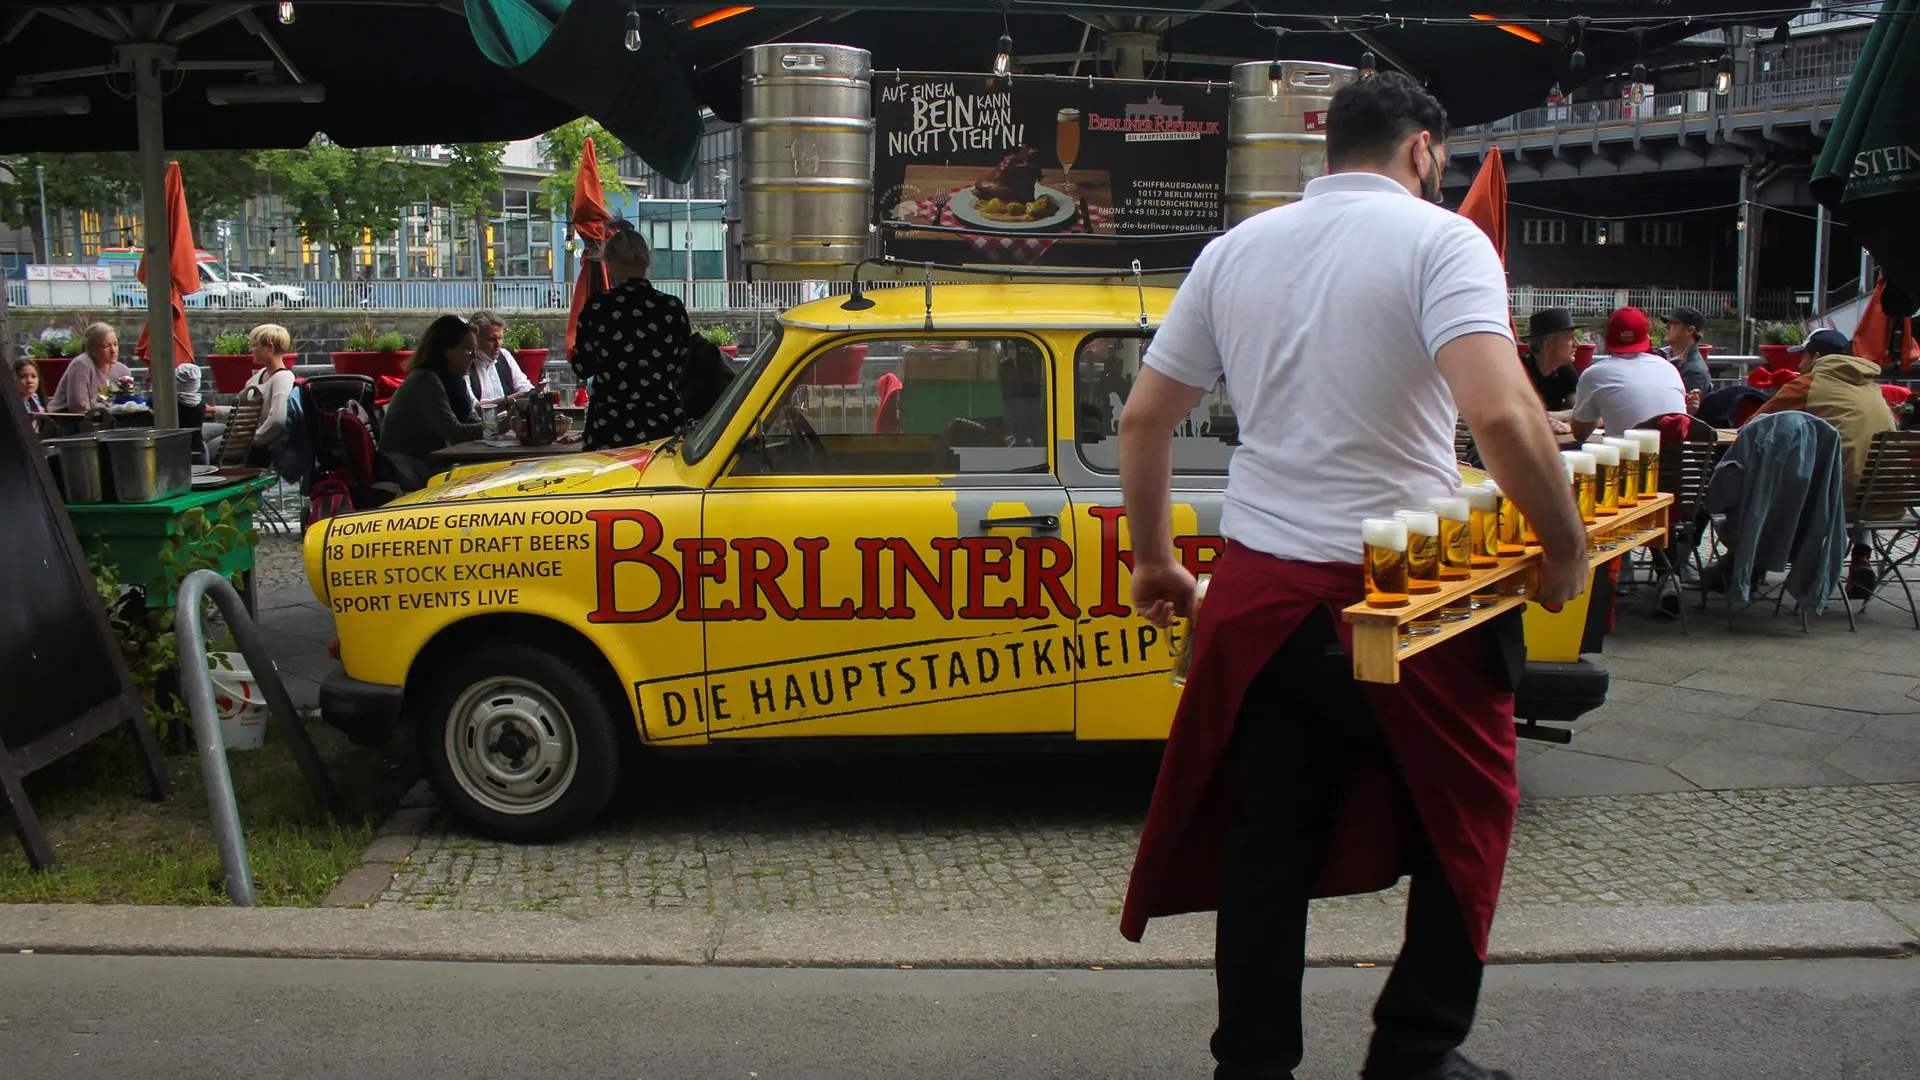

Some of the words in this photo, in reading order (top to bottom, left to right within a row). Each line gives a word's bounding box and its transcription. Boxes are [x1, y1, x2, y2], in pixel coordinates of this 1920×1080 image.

[882, 84, 909, 102] AUF
[912, 82, 955, 100] EINEM
[977, 92, 1010, 108] KANN
[911, 95, 974, 134] BEIN
[978, 108, 1010, 126] MAN
[1088, 113, 1154, 132] BERLINER
[889, 128, 945, 156] NICHT
[1849, 146, 1920, 178] STEIN
[1132, 180, 1212, 190] SCHIFFBAUERDAMM
[1143, 199, 1218, 209] FRIEDRICHSTRASSE
[1099, 222, 1218, 231] www.die-berliner-republik.de
[330, 520, 381, 538] HOME
[386, 515, 439, 532] MADE
[444, 512, 526, 528] GERMAN
[531, 510, 583, 525] FOOD
[326, 544, 344, 560] 18
[352, 538, 453, 559] DIFFERENT
[460, 536, 523, 554] DRAFT
[530, 534, 590, 552] BEERS
[331, 570, 378, 588] BEER
[384, 566, 447, 585] STOCK
[454, 560, 562, 581] EXCHANGE
[586, 508, 1080, 624] BERLINER
[333, 595, 392, 614] SPORT
[399, 590, 470, 610] EVENTS
[478, 588, 519, 606] LIVE
[663, 683, 732, 728] DIE
